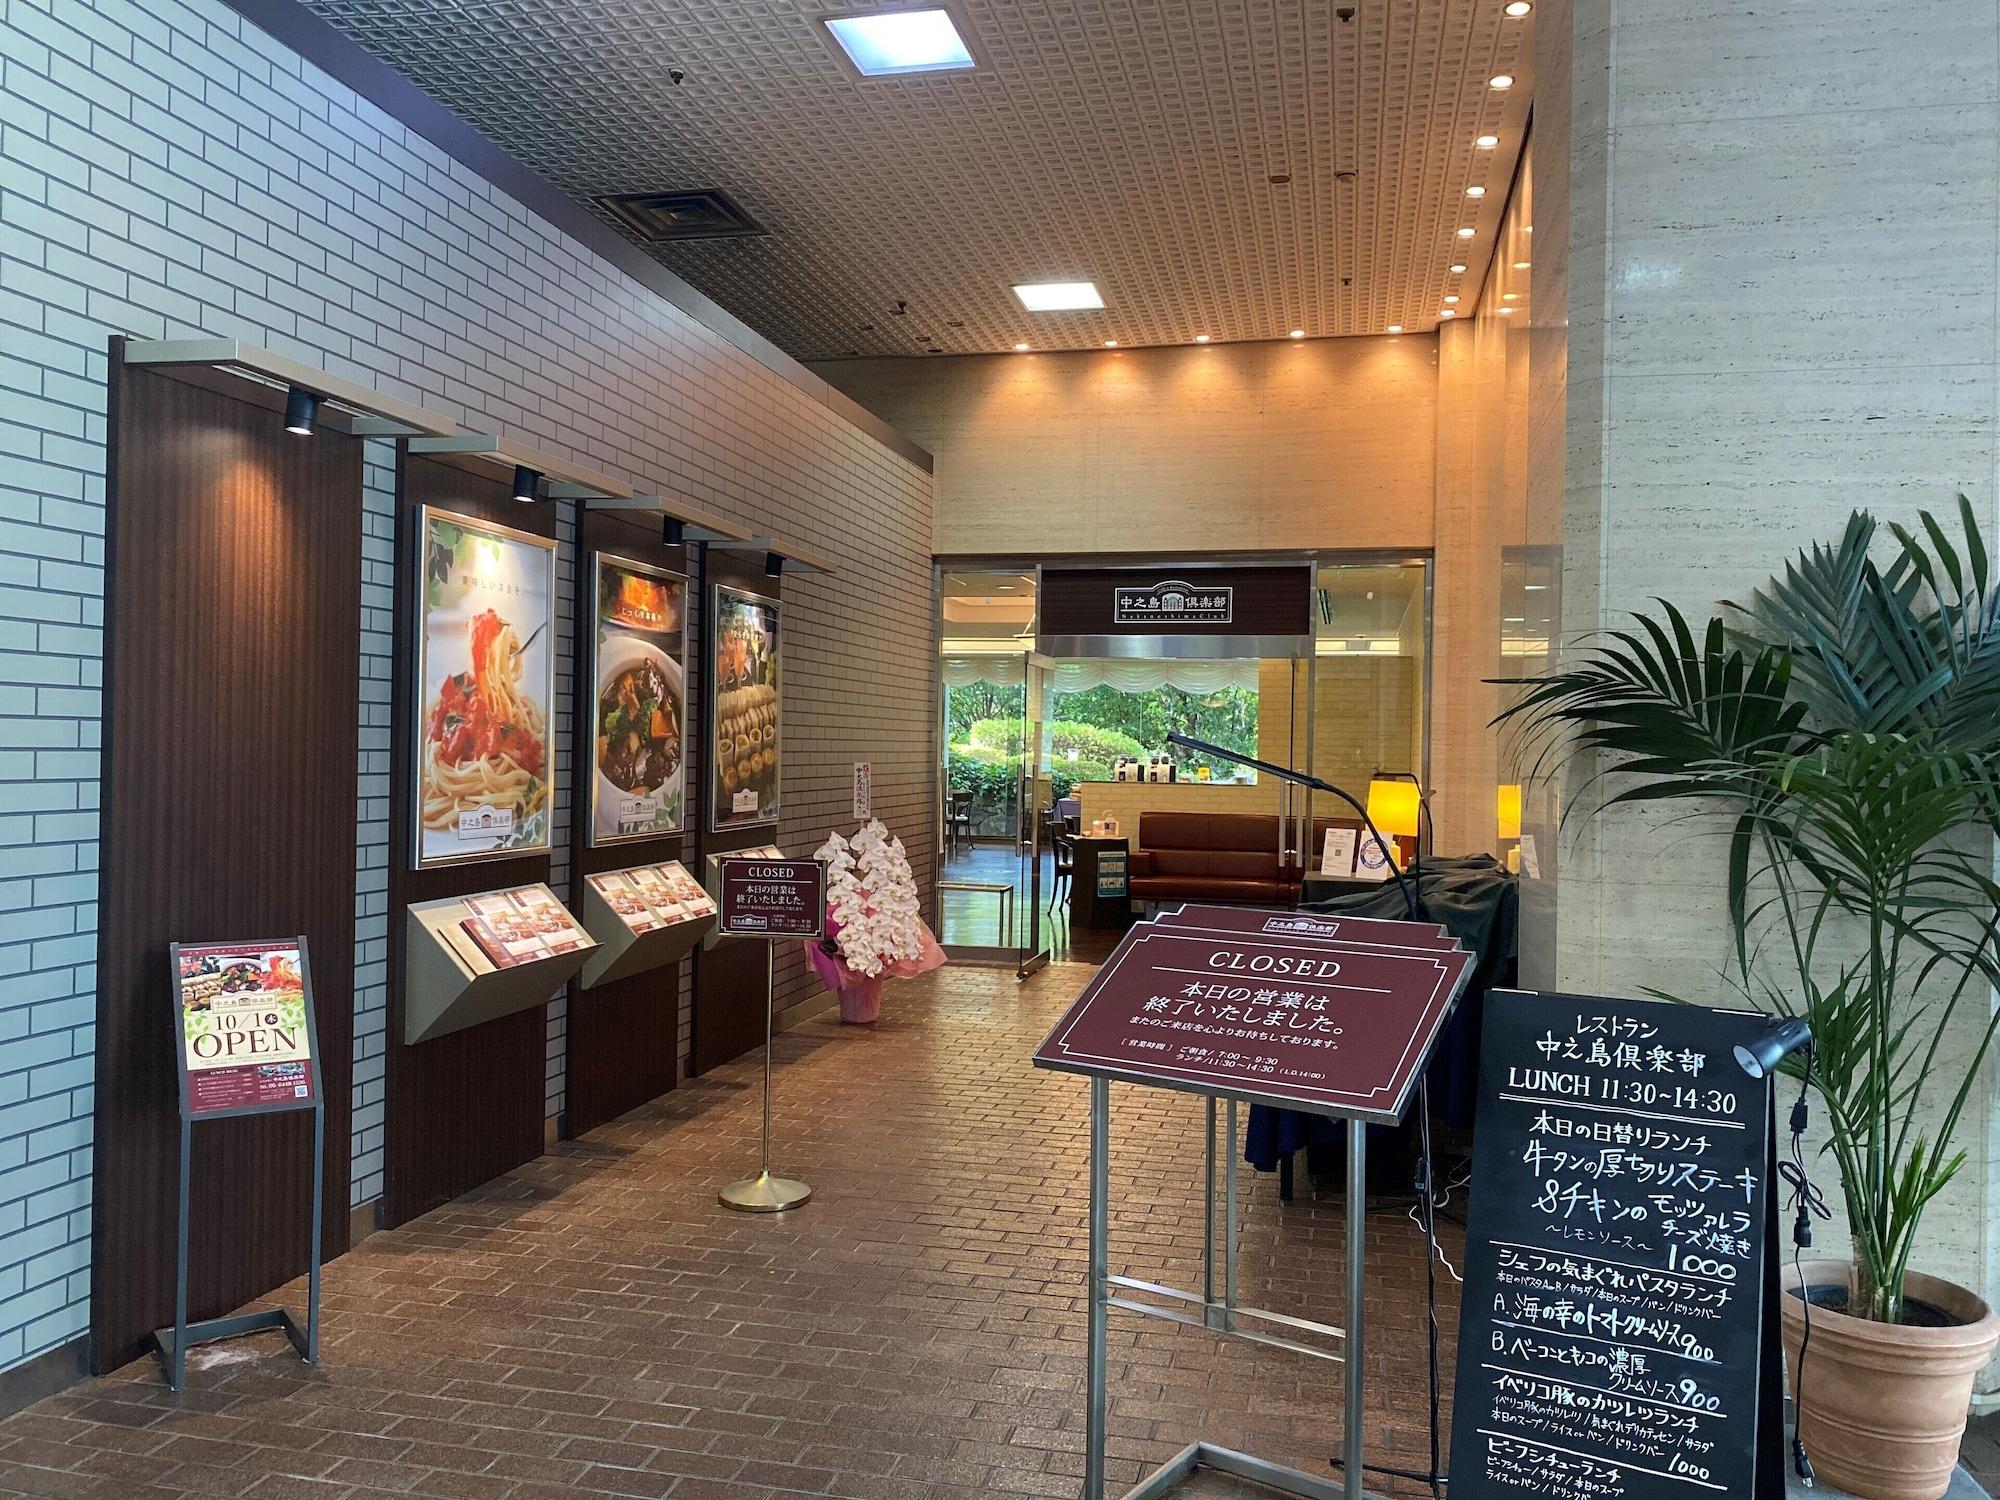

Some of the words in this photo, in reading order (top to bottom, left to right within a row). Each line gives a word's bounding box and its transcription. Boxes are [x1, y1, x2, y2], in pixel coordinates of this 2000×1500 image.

[1120, 595, 1160, 609] 中之島
[1185, 596, 1226, 608] 倶楽部
[748, 867, 794, 878] CLOSED
[736, 894, 806, 906] 終了いたしました。
[745, 885, 796, 895] 本日の営業は
[1208, 950, 1342, 978] CLOSED
[1179, 981, 1332, 1012] 本日の営業は
[1129, 1016, 1340, 1050] またのご来店を心よりお待ちしております。
[1142, 996, 1346, 1036] 終了いたしました。
[1576, 1014, 1658, 1038] レストラン
[194, 1027, 296, 1058] OPEN
[1535, 1030, 1706, 1078] 中之島倶楽部
[1508, 1066, 1590, 1097] LUNCH
[1528, 1109, 1712, 1156] 本日の日替りランチ
[1522, 1139, 1758, 1204] 牛タンの厚切りステーキ
[1661, 1219, 1752, 1260] チーズ焼き
[1498, 1248, 1732, 1307] シェフの気まぐれパスタランチ
[1668, 1244, 1736, 1280] 1000
[1492, 1374, 1700, 1434] イベリコ豚のカツレツランチ
[1608, 1373, 1680, 1404] クリームソース
[1680, 1378, 1721, 1411] 900
[1488, 1437, 1622, 1484] ビーフシチューランチ
[1668, 1452, 1710, 1480] 1000
